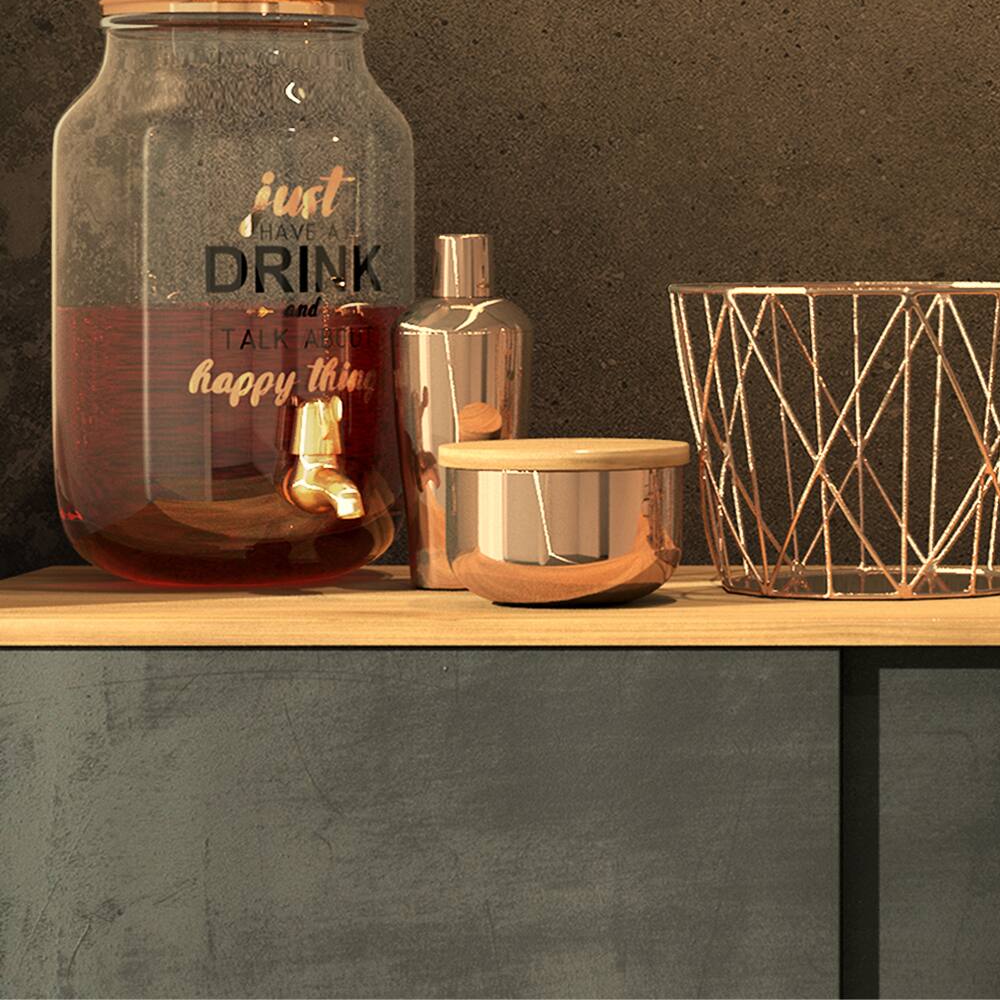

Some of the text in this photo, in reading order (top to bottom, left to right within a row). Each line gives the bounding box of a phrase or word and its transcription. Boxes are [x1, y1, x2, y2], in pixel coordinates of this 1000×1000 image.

[239, 165, 356, 238] just
[260, 223, 317, 240] HAVE
[205, 245, 382, 293] DRINK
[284, 296, 321, 318] and
[221, 328, 289, 350] TALK
[189, 358, 297, 408] happy
